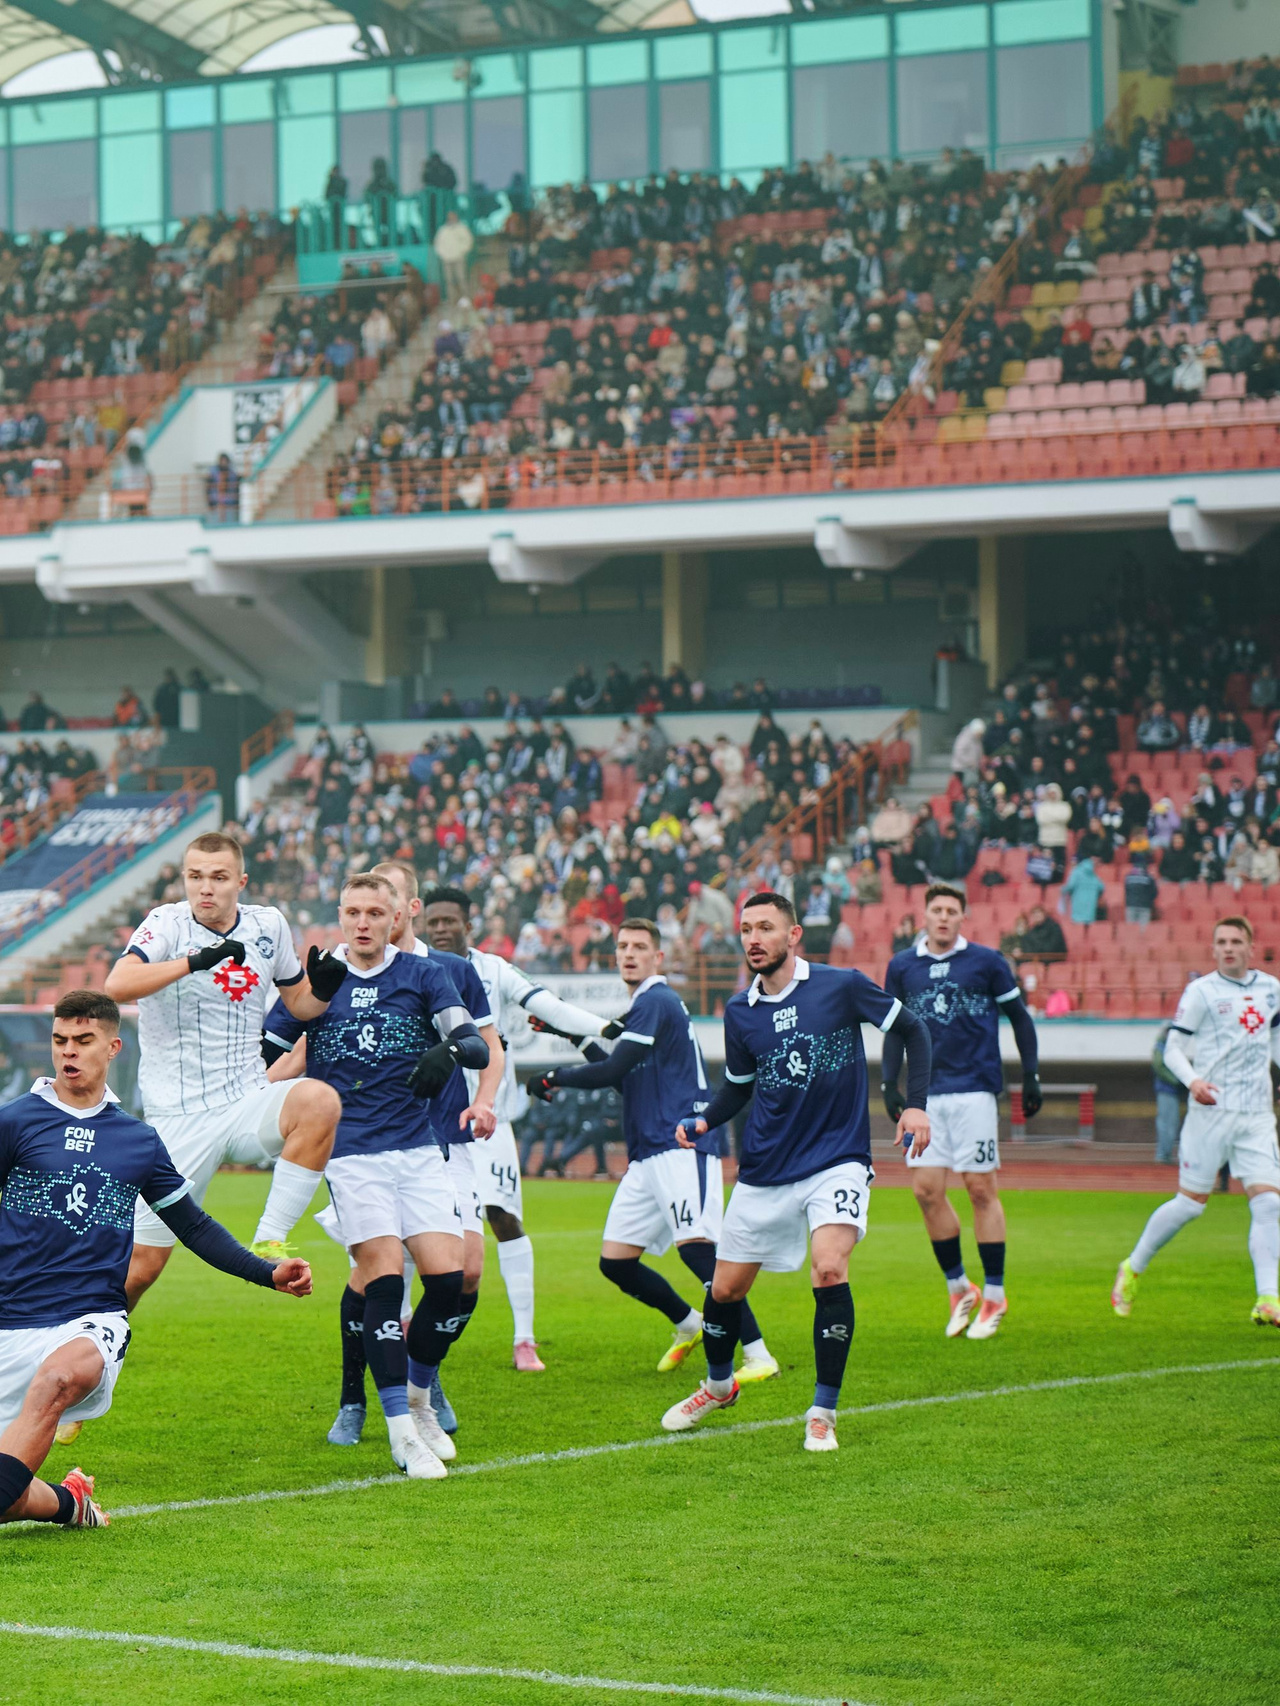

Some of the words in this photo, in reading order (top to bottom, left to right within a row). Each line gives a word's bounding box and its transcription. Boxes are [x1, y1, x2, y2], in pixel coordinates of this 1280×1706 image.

[350, 986, 379, 998] FON
[350, 997, 379, 1008] BET
[772, 1005, 797, 1023] FON
[774, 1015, 799, 1033] BET
[64, 1126, 96, 1141] FON
[64, 1138, 96, 1153] BET
[974, 1139, 995, 1163] 38
[490, 1162, 518, 1193] 44
[834, 1188, 861, 1219] 23
[670, 1199, 693, 1229] 14
